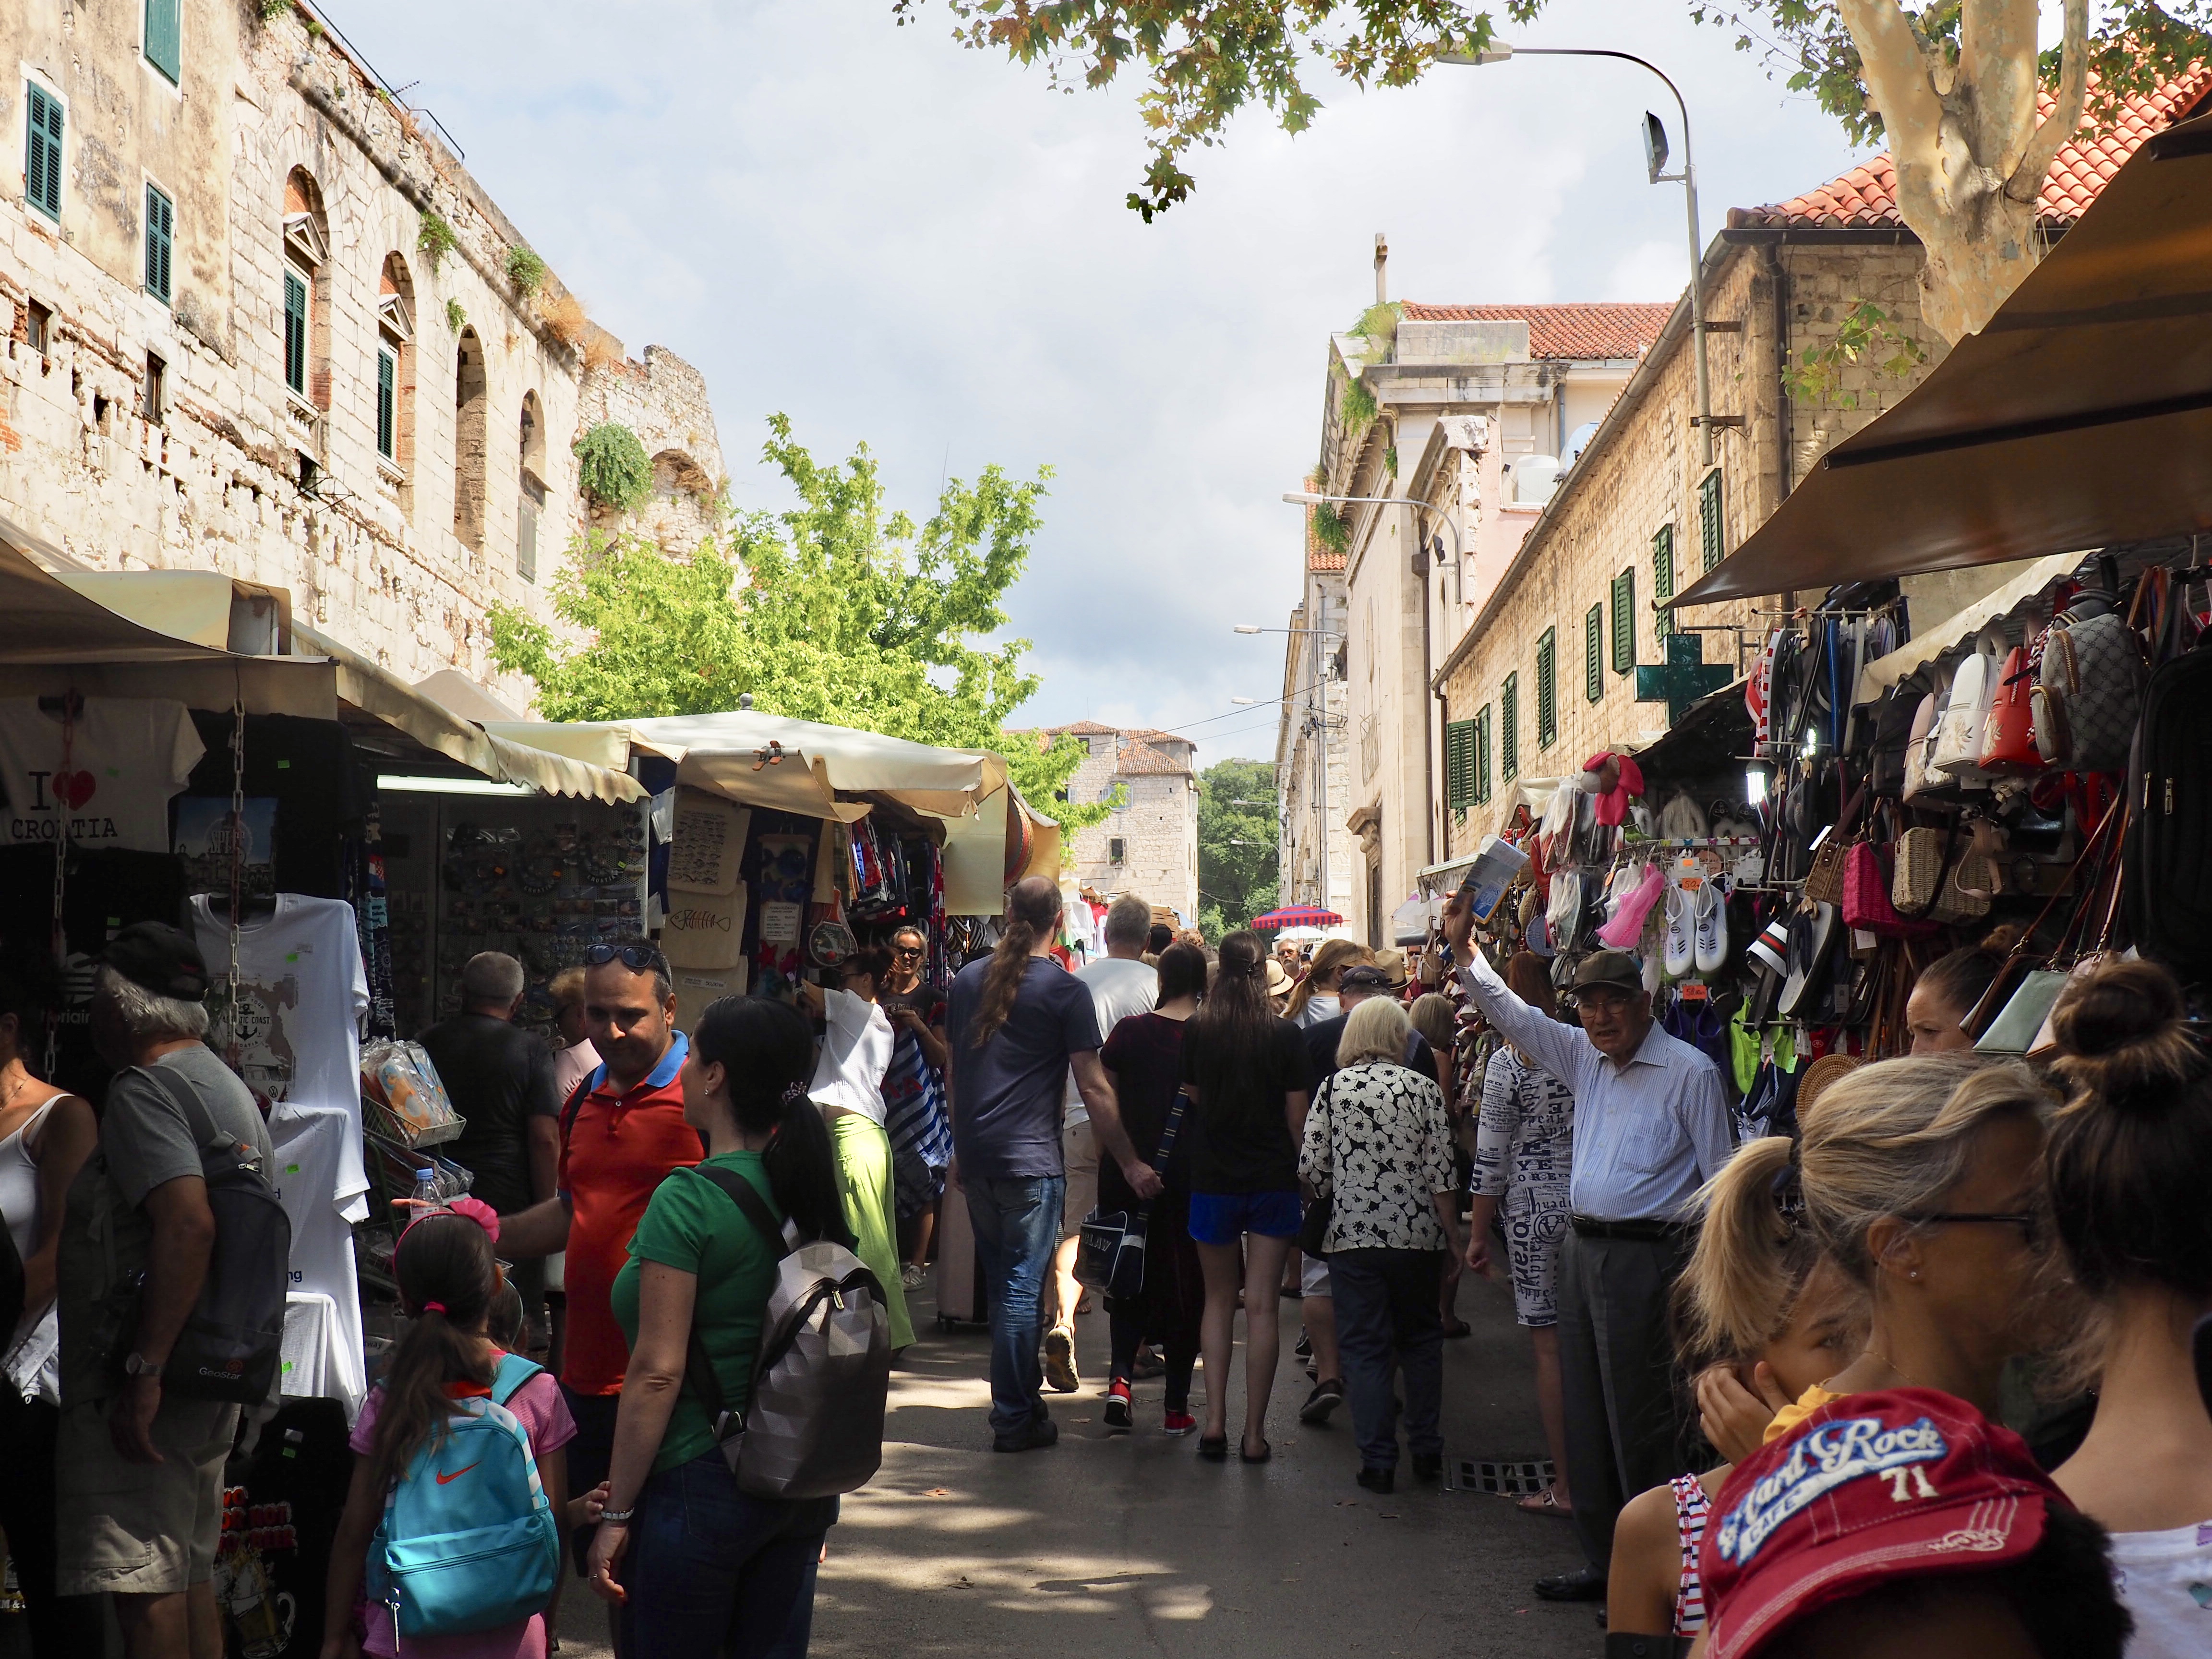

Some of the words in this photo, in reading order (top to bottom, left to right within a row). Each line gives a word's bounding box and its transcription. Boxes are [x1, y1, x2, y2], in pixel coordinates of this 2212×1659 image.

[28, 771, 51, 811] I
[251, 998, 264, 1009] TOUR
[1081, 1231, 1112, 1252] CLAW
[199, 1367, 242, 1381] GeoStar
[1809, 1418, 1941, 1473] Rock
[1880, 1466, 1940, 1502] 71
[1749, 1493, 1798, 1543] CAFE
